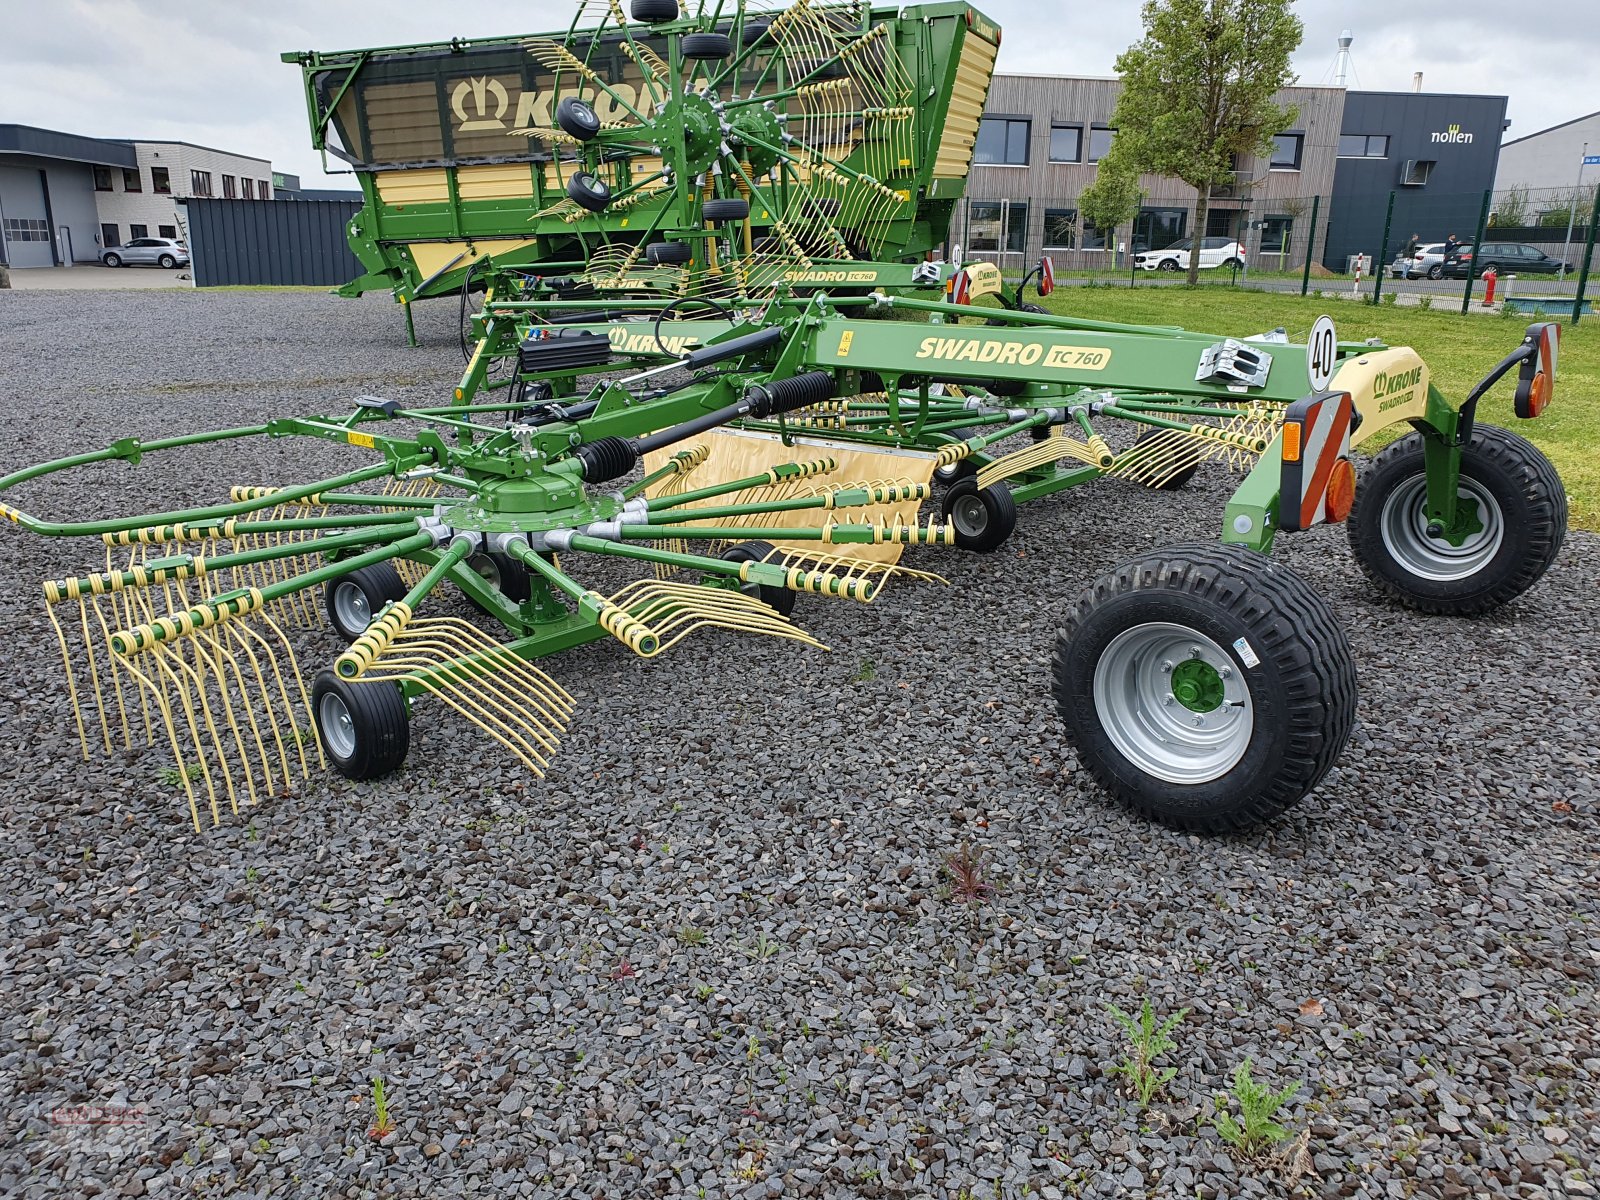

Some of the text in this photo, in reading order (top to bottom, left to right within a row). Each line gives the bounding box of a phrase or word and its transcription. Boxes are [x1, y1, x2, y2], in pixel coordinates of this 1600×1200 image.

[1431, 125, 1473, 144] nollen
[784, 271, 846, 282] SWADRO
[915, 337, 1104, 366] SWADRO TC 760
[1312, 328, 1333, 379] 40
[1385, 365, 1423, 396] KRONE
[1378, 395, 1405, 414] SWADRO
